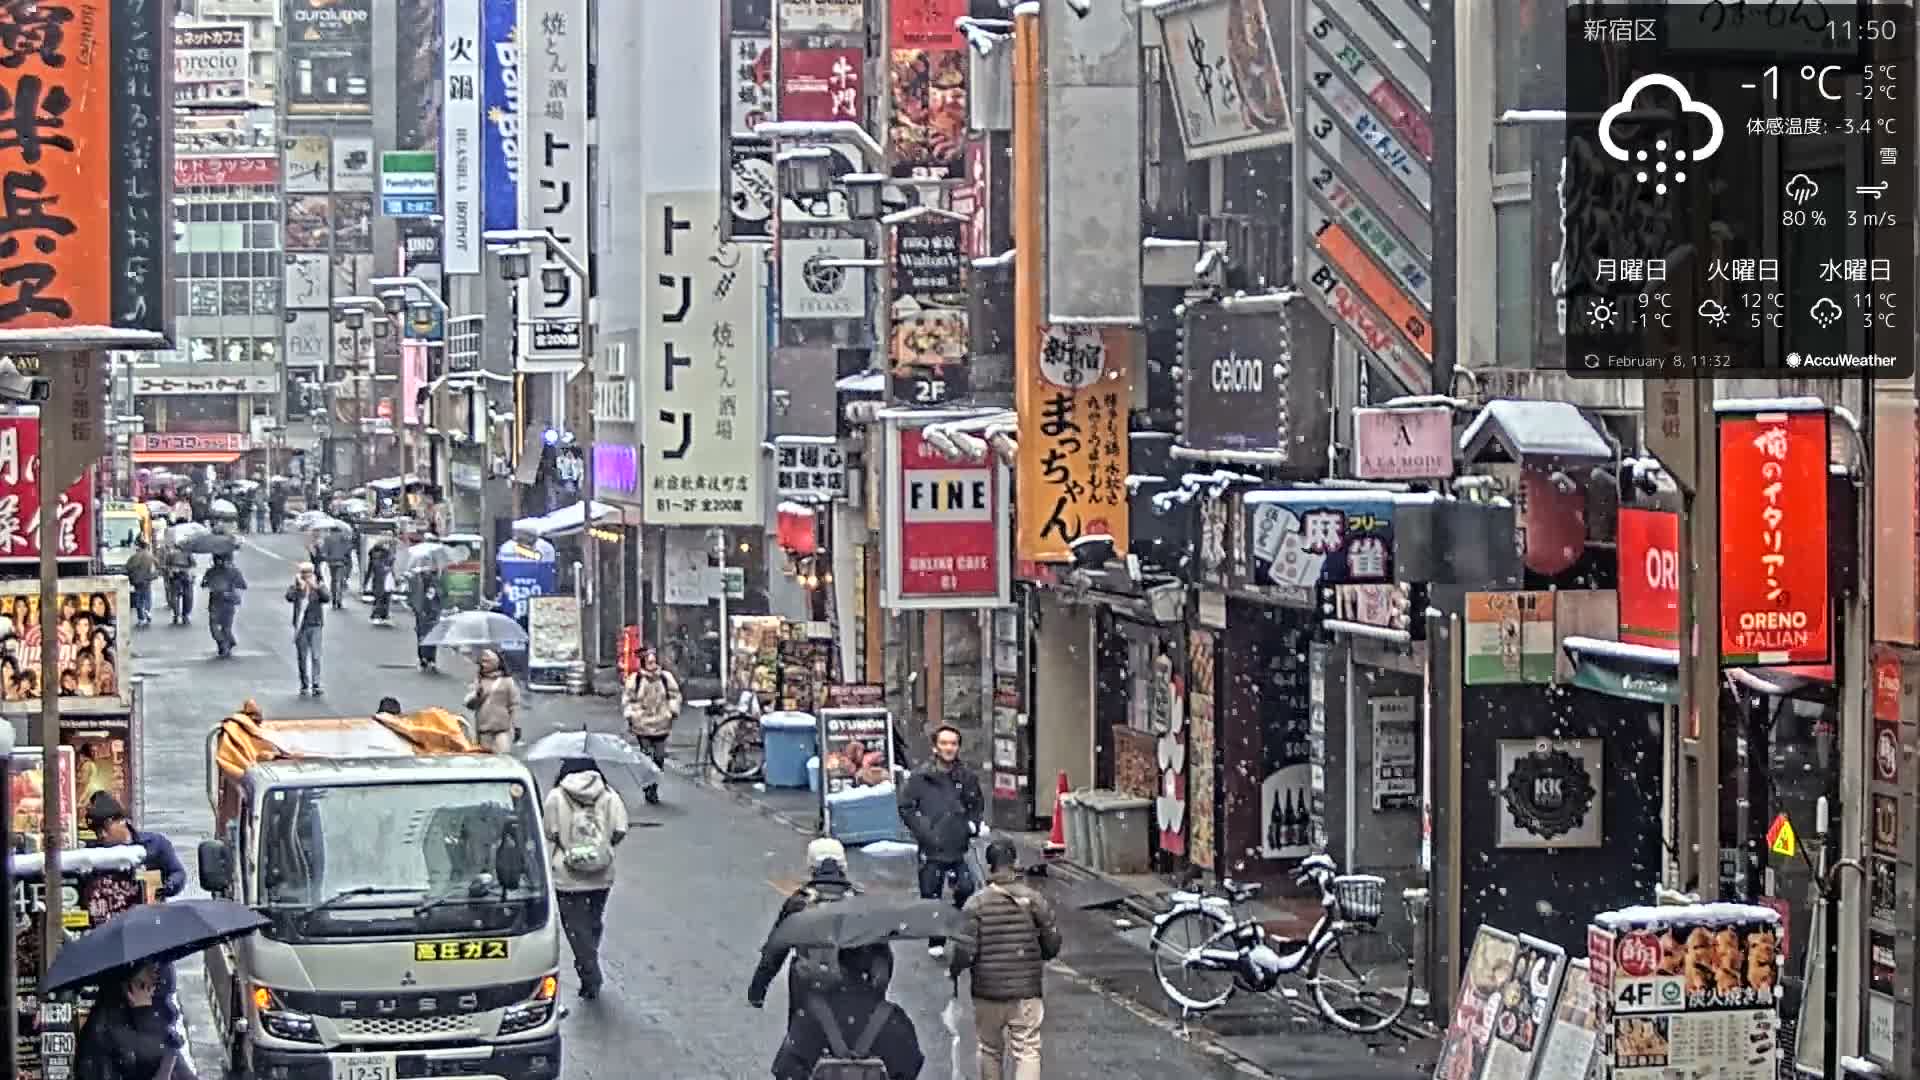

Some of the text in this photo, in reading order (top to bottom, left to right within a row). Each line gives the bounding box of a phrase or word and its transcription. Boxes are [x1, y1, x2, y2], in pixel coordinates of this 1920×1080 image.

[1313, 18, 1333, 39] 5
[449, 37, 473, 101] 火鍋
[1313, 71, 1332, 89] 4
[1313, 118, 1333, 140] 3
[1312, 168, 1333, 190] 2
[658, 206, 692, 460] トントン
[915, 381, 946, 401] 2F
[1041, 391, 1084, 544] まっちゃん
[911, 480, 985, 509] FINE
[1348, 515, 1389, 531] フリー
[1752, 425, 1789, 601] 俺のイタリアン
[1303, 509, 1388, 578] 麻雀
[1740, 612, 1808, 631] ORENO
[1736, 631, 1808, 647] ITALIAN
[416, 941, 505, 960] 高圧ガス
[340, 992, 478, 1014] FUSO
[1619, 983, 1653, 1006] 4F
[43, 1034, 74, 1053] NERO
